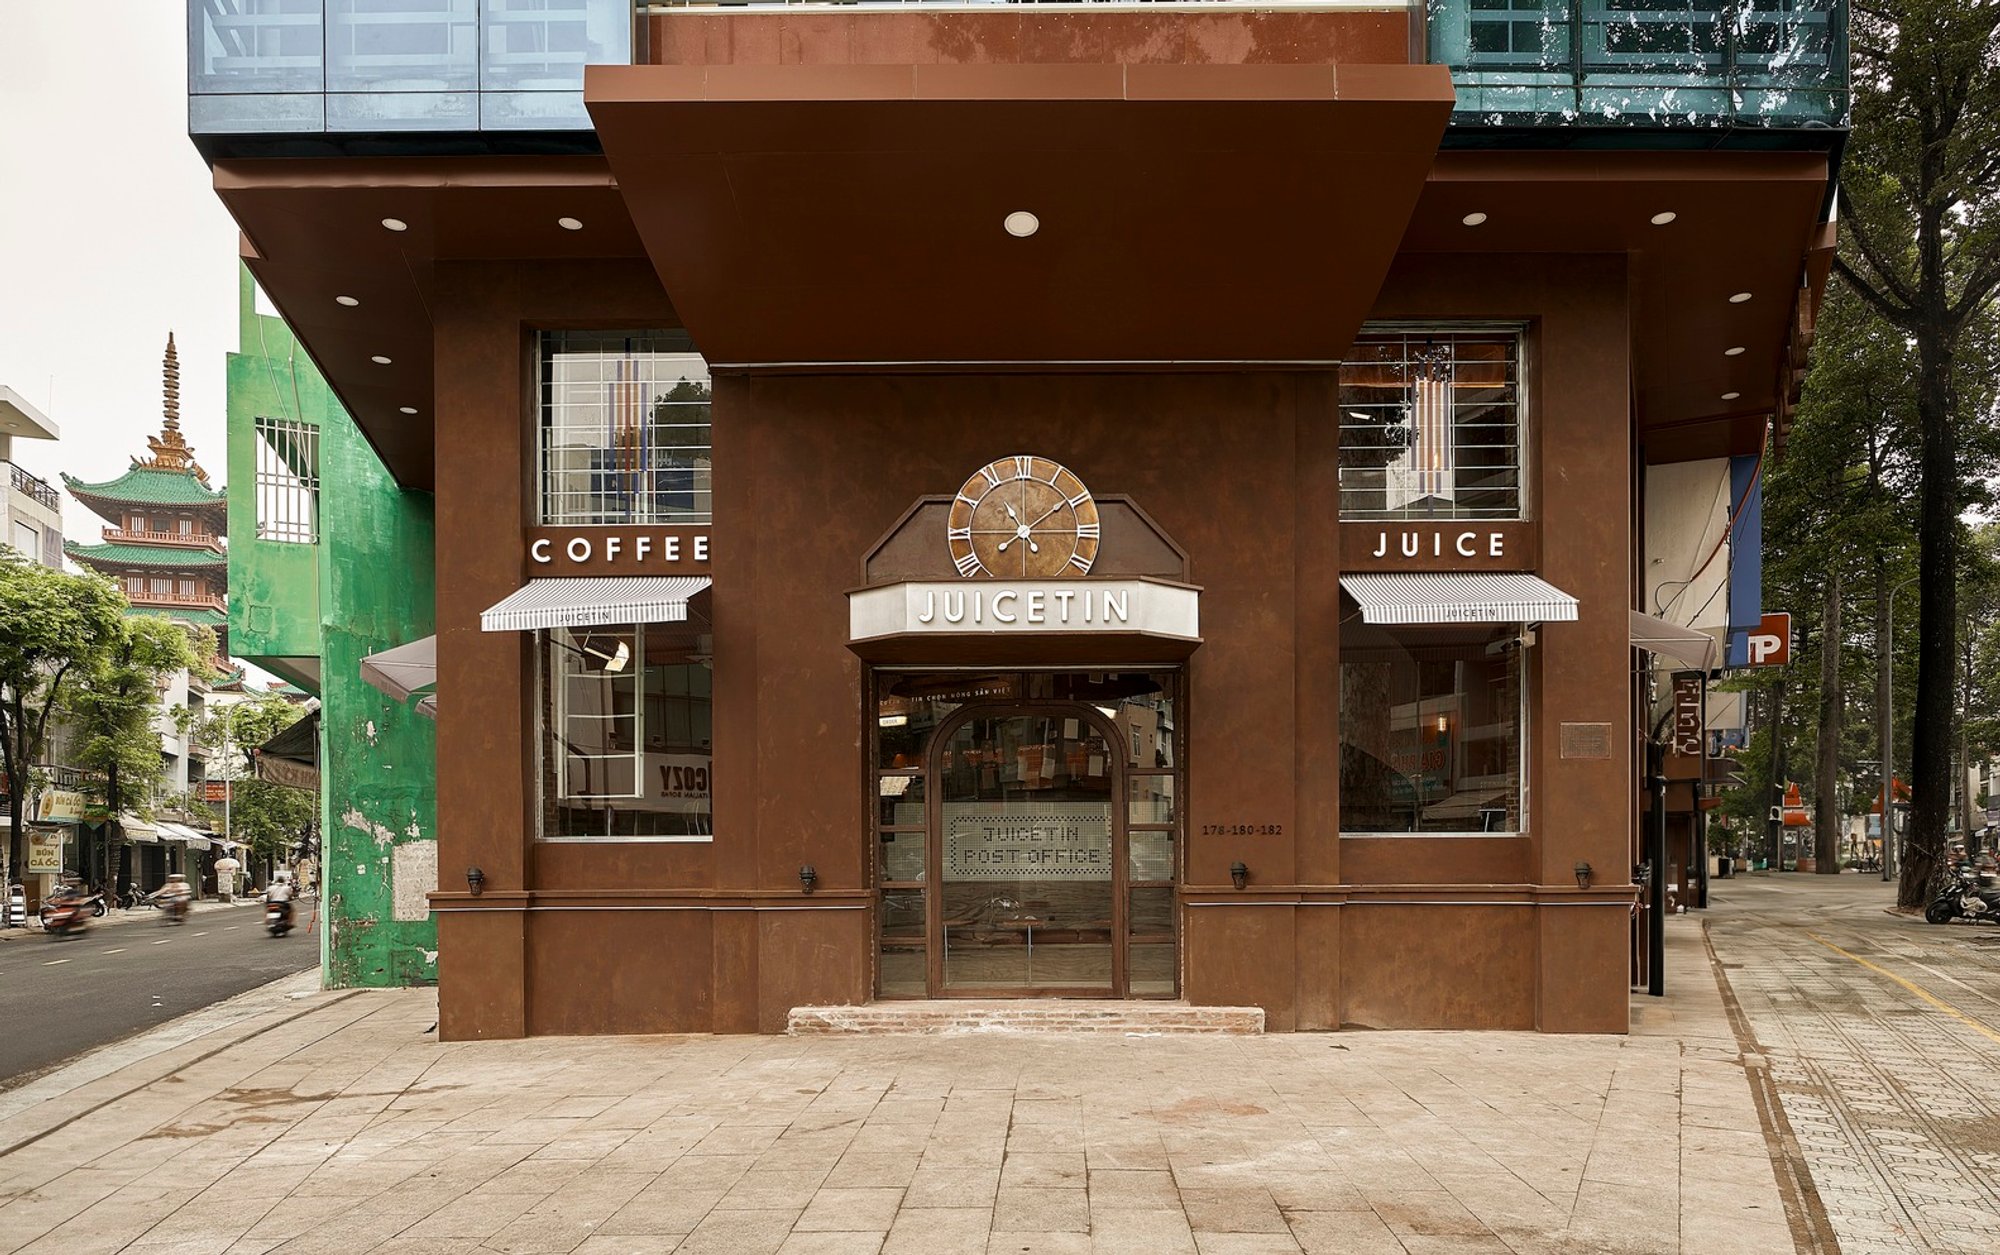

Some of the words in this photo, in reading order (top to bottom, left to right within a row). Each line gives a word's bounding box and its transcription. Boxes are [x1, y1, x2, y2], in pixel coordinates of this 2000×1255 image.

[531, 536, 708, 563] COFFEE
[1373, 532, 1504, 557] JUICE
[919, 590, 1129, 623] JUICETIN
[1446, 609, 1496, 618] JUICETIN
[559, 612, 609, 622] JUICETIN
[983, 827, 1079, 842] JUICETIN
[1202, 825, 1282, 836] 178-180-182
[36, 848, 54, 856] BÚN
[964, 849, 1020, 864] POST
[1027, 849, 1100, 864] OFFICE
